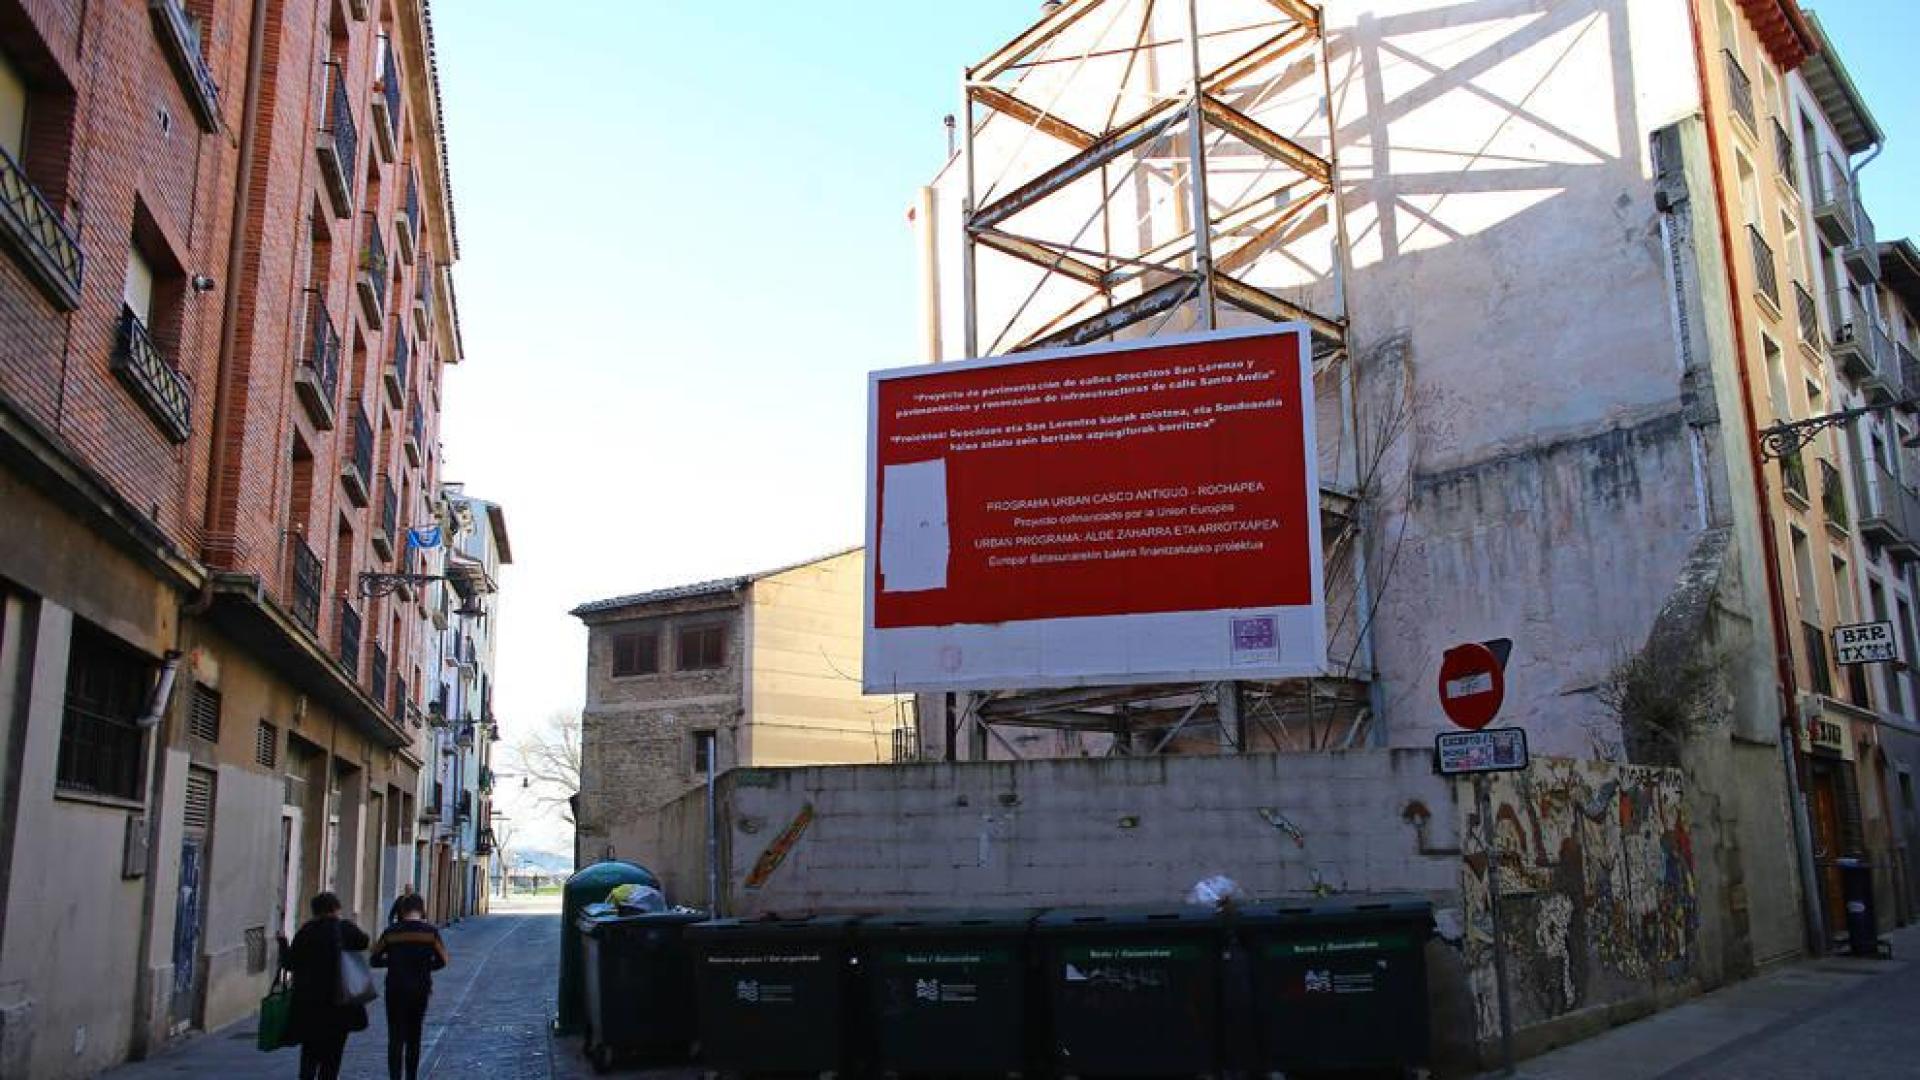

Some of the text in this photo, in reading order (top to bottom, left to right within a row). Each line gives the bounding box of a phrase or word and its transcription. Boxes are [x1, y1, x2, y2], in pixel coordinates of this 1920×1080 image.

[967, 389, 979, 397] de
[1063, 378, 1077, 387] de
[1174, 365, 1196, 375] San
[1198, 360, 1244, 372] Lorenzo
[1247, 360, 1255, 369] y
[974, 403, 981, 413] y
[1044, 393, 1057, 402] de
[1152, 382, 1166, 391] de
[1169, 378, 1197, 389] calle
[1200, 374, 1233, 387] Santo
[1006, 424, 1023, 433] eta
[1025, 422, 1046, 431] San
[1193, 405, 1212, 414] eta
[1041, 431, 1083, 443] bertako
[986, 497, 1050, 512] PROGRAMA
[1051, 494, 1091, 507] URBAN
[1093, 490, 1133, 504] CASCO
[1136, 486, 1188, 500] ANTIGUO
[1198, 481, 1265, 496] ROCHAPEA
[974, 537, 1014, 549] URBAN
[1085, 528, 1115, 542] ALDE
[1116, 525, 1172, 540] ZAHARRA
[1174, 523, 1197, 536] ETA
[1198, 518, 1279, 534] ARROTXAPEA
[1013, 516, 1058, 528] Proyecto
[1124, 510, 1142, 520] por
[1843, 626, 1886, 644] BAR
